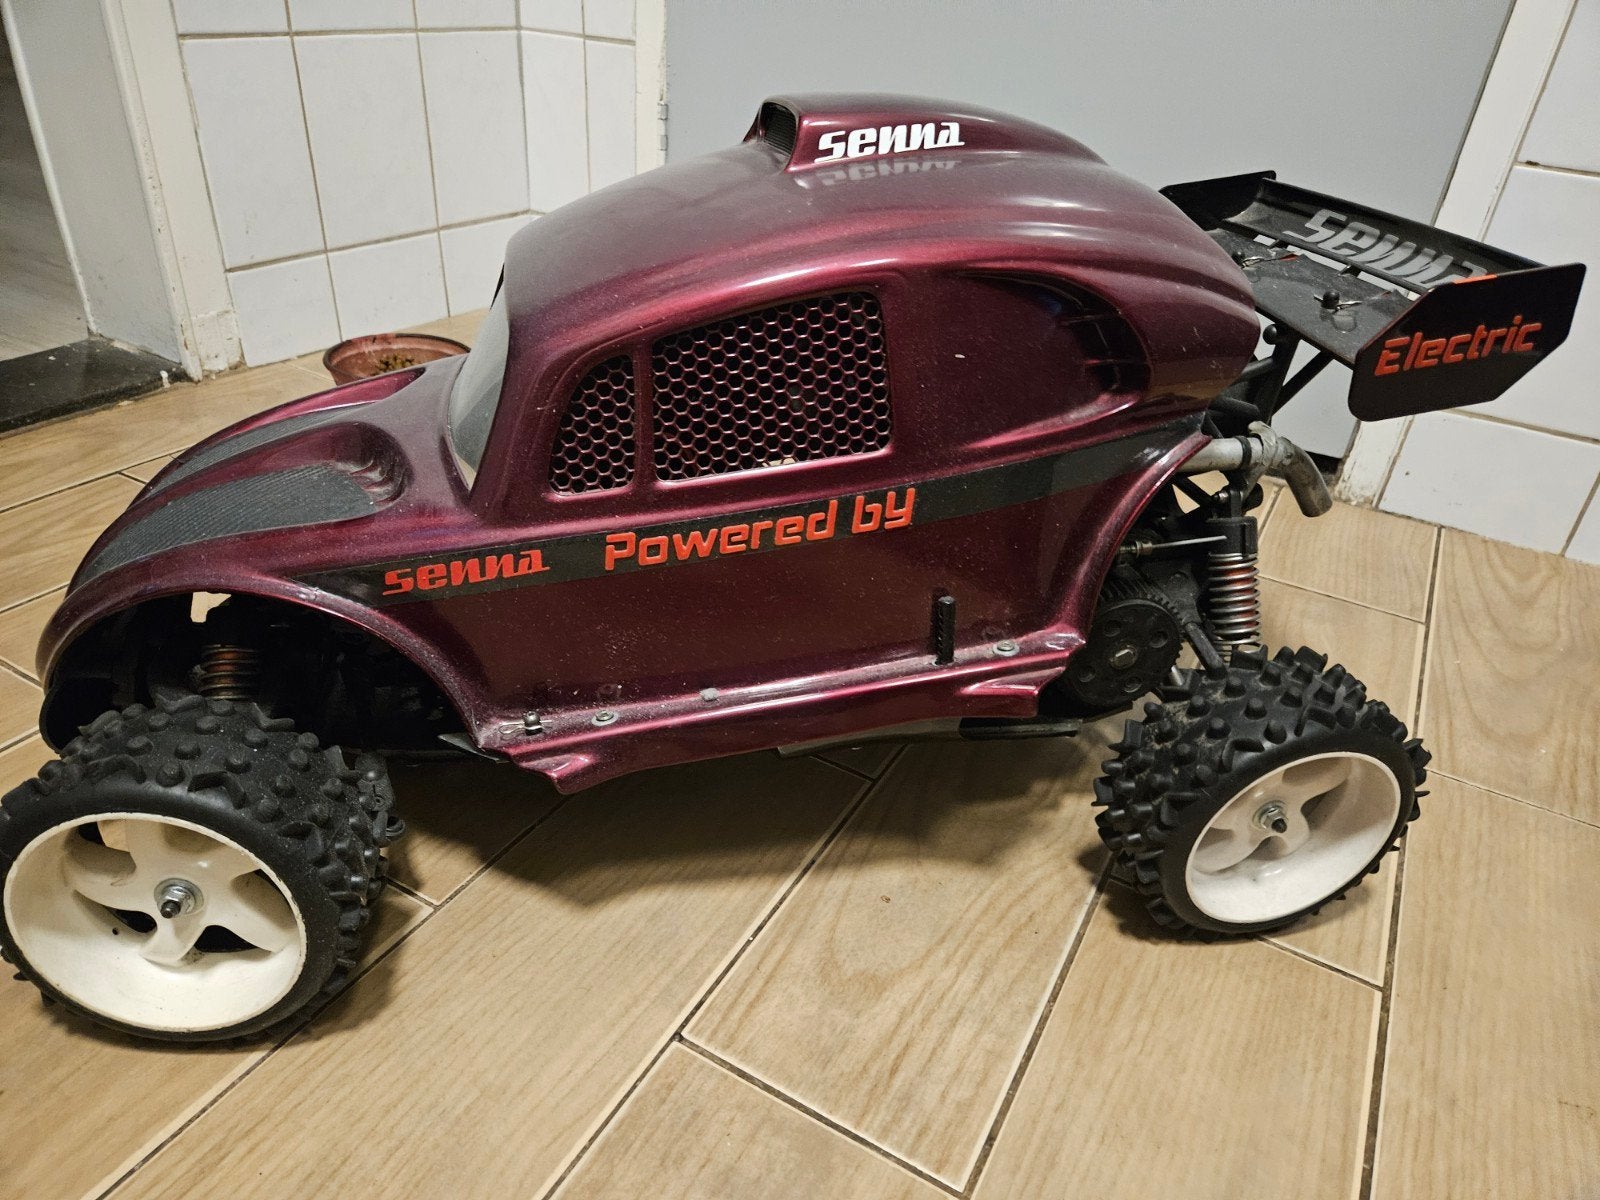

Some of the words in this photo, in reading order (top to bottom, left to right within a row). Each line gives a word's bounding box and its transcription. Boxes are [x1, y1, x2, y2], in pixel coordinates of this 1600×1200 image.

[814, 122, 965, 163] senna
[1374, 315, 1542, 376] Electric
[382, 549, 550, 596] senna
[604, 500, 838, 571] Powered
[852, 487, 916, 533] by
